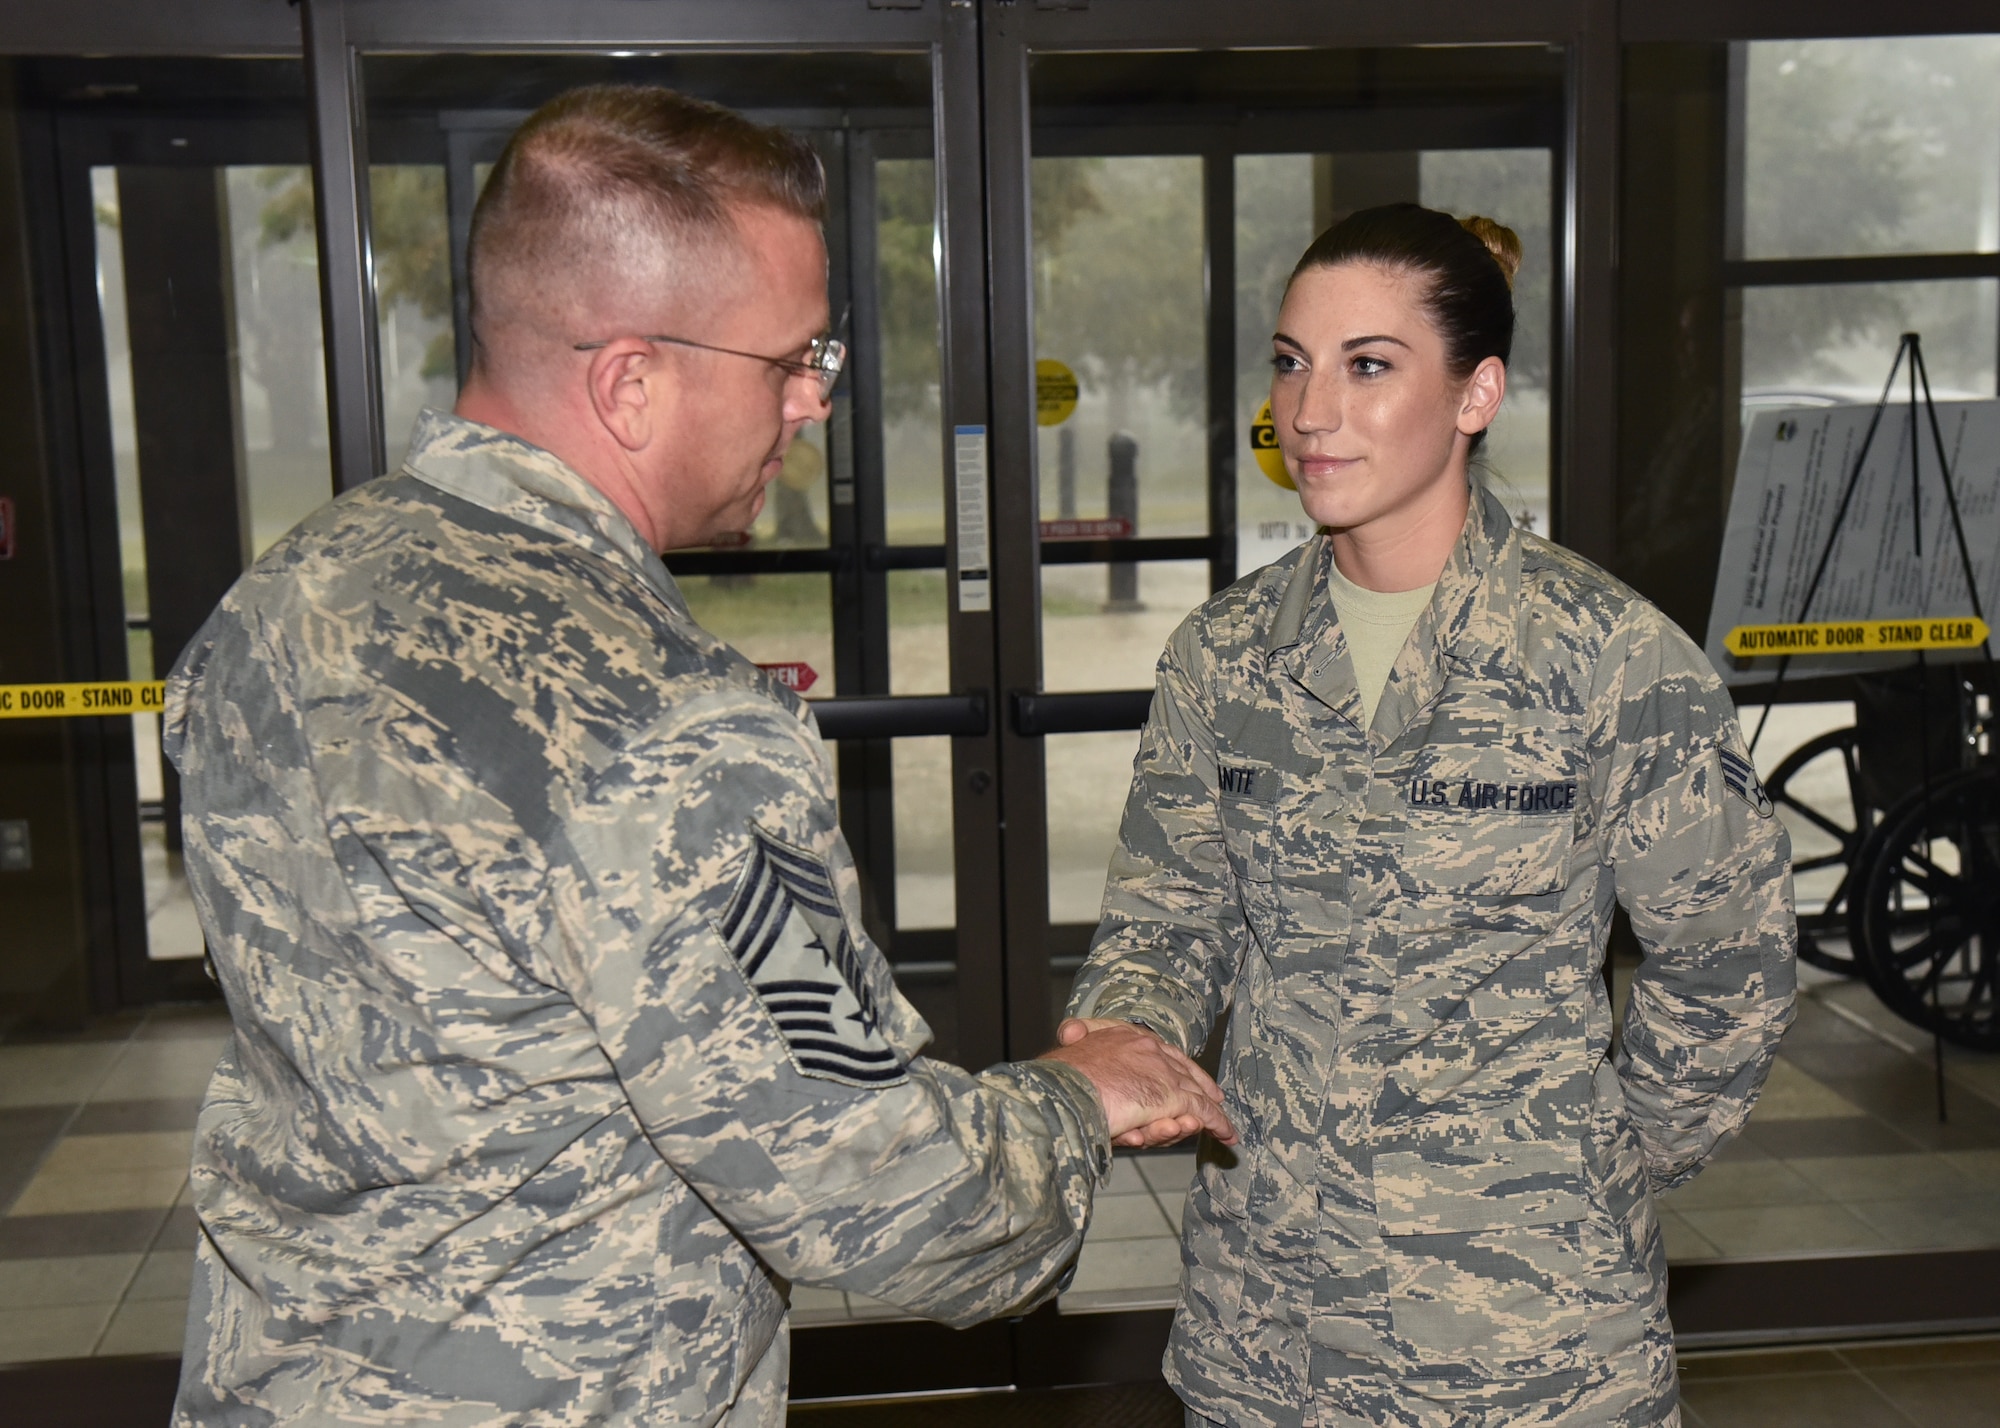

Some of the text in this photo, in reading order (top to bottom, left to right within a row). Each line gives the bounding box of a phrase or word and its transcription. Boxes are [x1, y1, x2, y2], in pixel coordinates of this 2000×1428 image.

[1739, 623, 1973, 649] AUTOMATIC DOOR STAND CLEAR
[21, 690, 65, 709] DOOR
[82, 688, 133, 707] STAND
[1411, 780, 1577, 811] U.S. AIR FORCE
